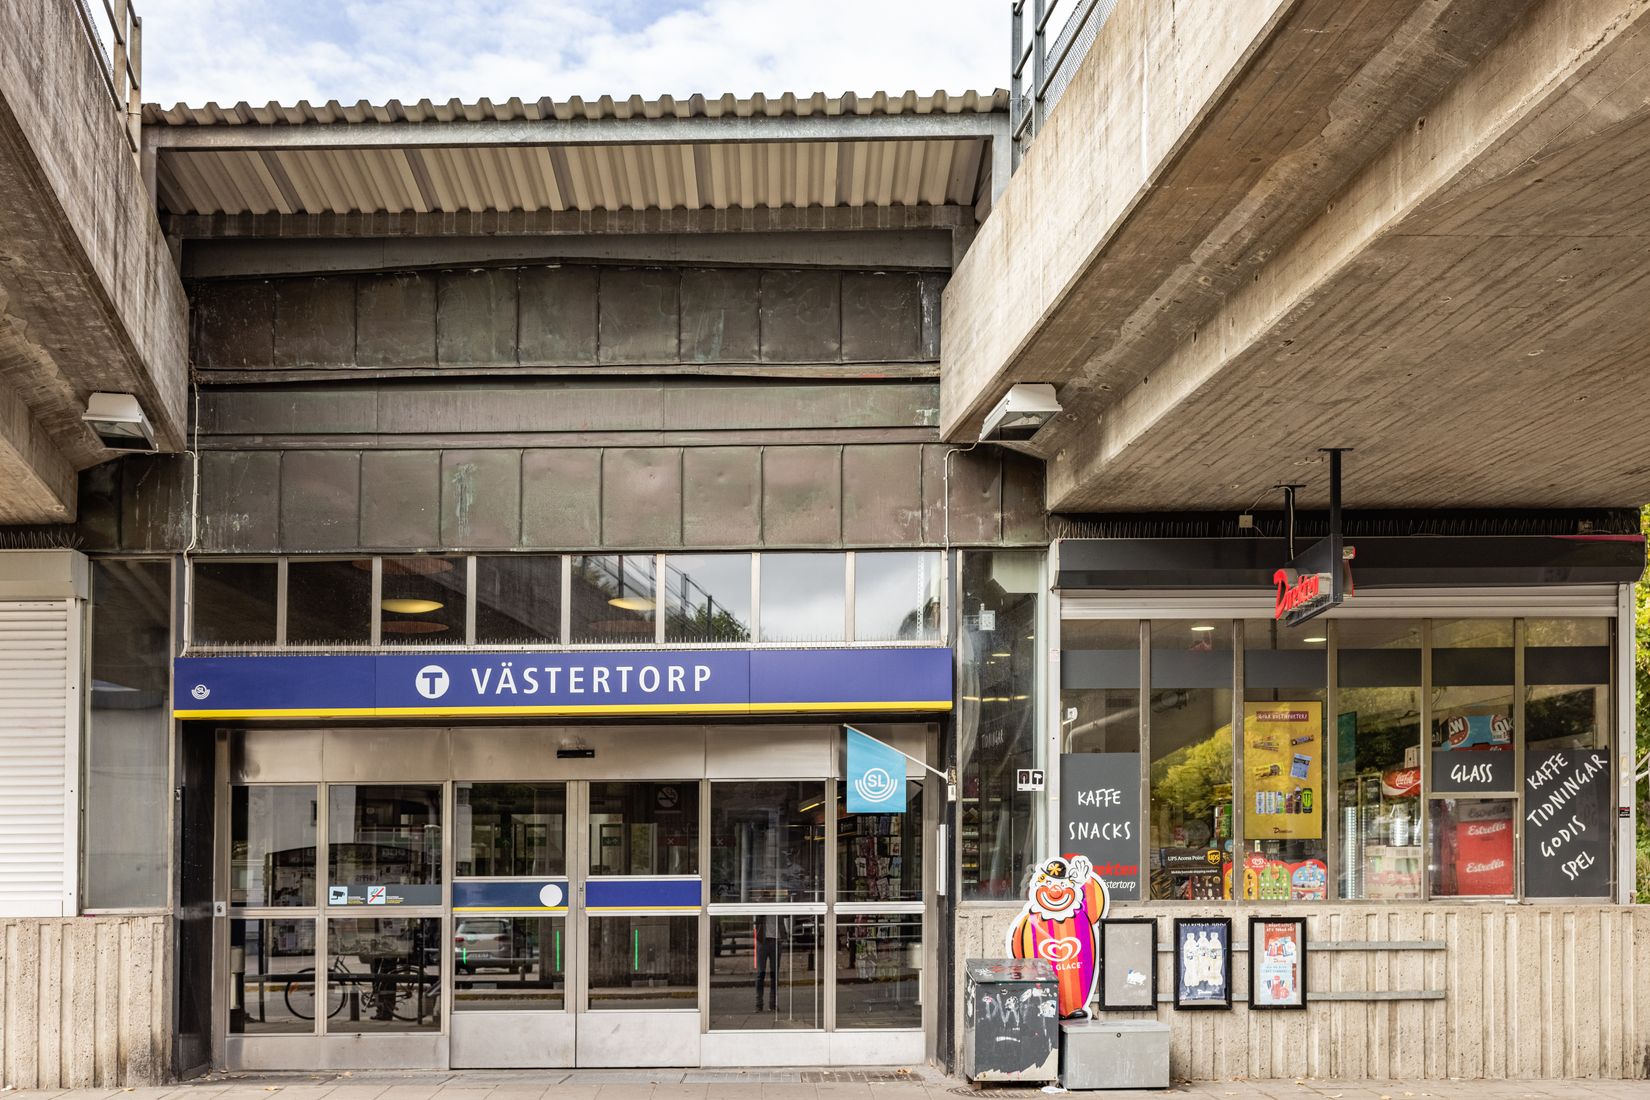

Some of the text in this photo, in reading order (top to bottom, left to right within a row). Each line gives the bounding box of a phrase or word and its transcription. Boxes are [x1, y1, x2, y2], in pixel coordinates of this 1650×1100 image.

[471, 661, 712, 696] VÄSTERTORP
[867, 774, 886, 788] SL
[1450, 763, 1493, 784] GLASS
[1526, 752, 1569, 790] KAFFE
[1077, 788, 1122, 807] KAFFE
[1526, 754, 1608, 828] TIDNINGAR
[1068, 821, 1132, 841] SNACKS
[1467, 821, 1506, 836] Estrella
[1540, 815, 1587, 858] GODIS
[1466, 858, 1505, 874] Estrella
[1561, 850, 1595, 881] SPEL
[1102, 879, 1136, 892] stertorp
[1055, 962, 1081, 971] GLACE
